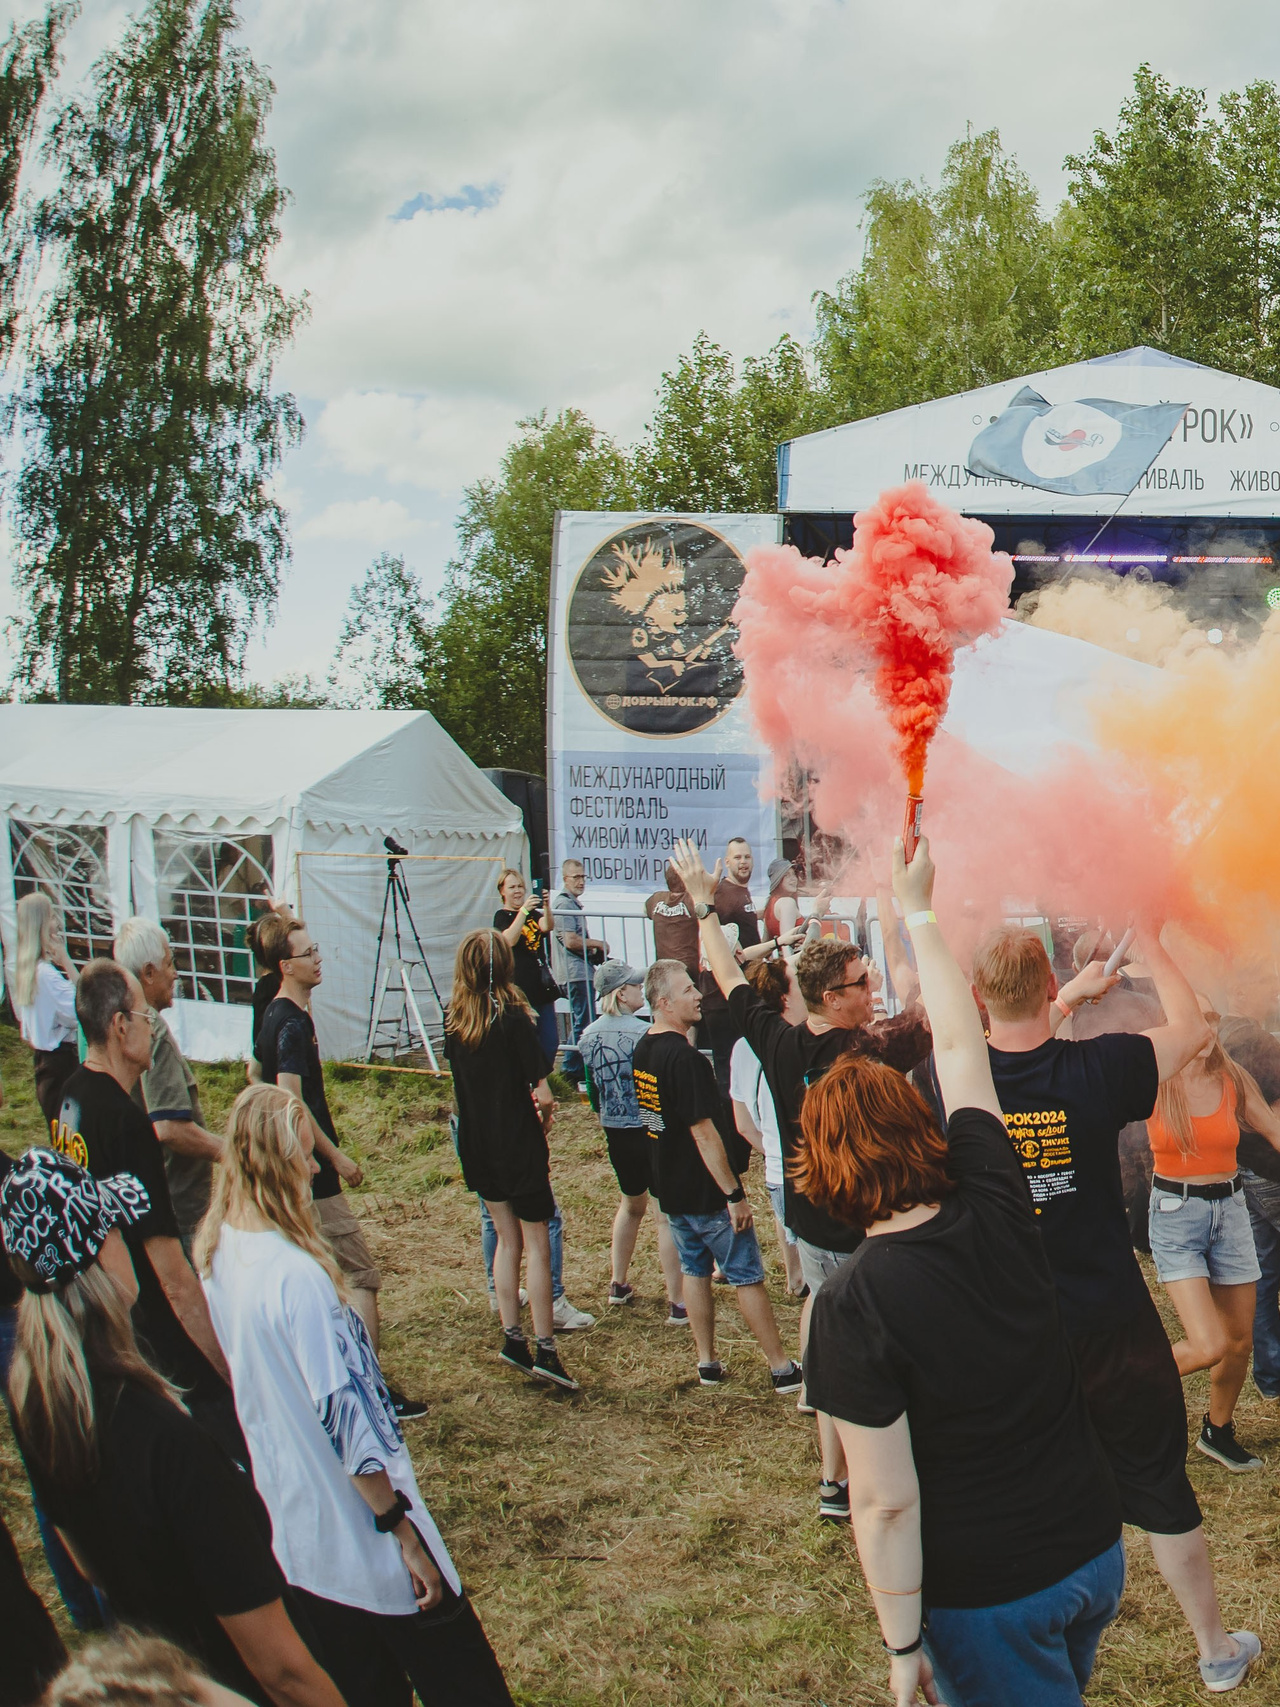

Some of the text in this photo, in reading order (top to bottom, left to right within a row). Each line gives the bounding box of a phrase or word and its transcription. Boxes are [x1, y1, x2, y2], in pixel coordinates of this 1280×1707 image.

[1182, 408, 1254, 444] РОК»
[621, 694, 719, 709] ДОБРЫЙРОК.РФ
[569, 764, 726, 793] МЕЖДУНАРОДНЫЙ
[569, 795, 669, 819] ФЕСТИВАЛЬ
[571, 823, 630, 850] ЖИВОЙ
[15, 1203, 59, 1261] ROCK
